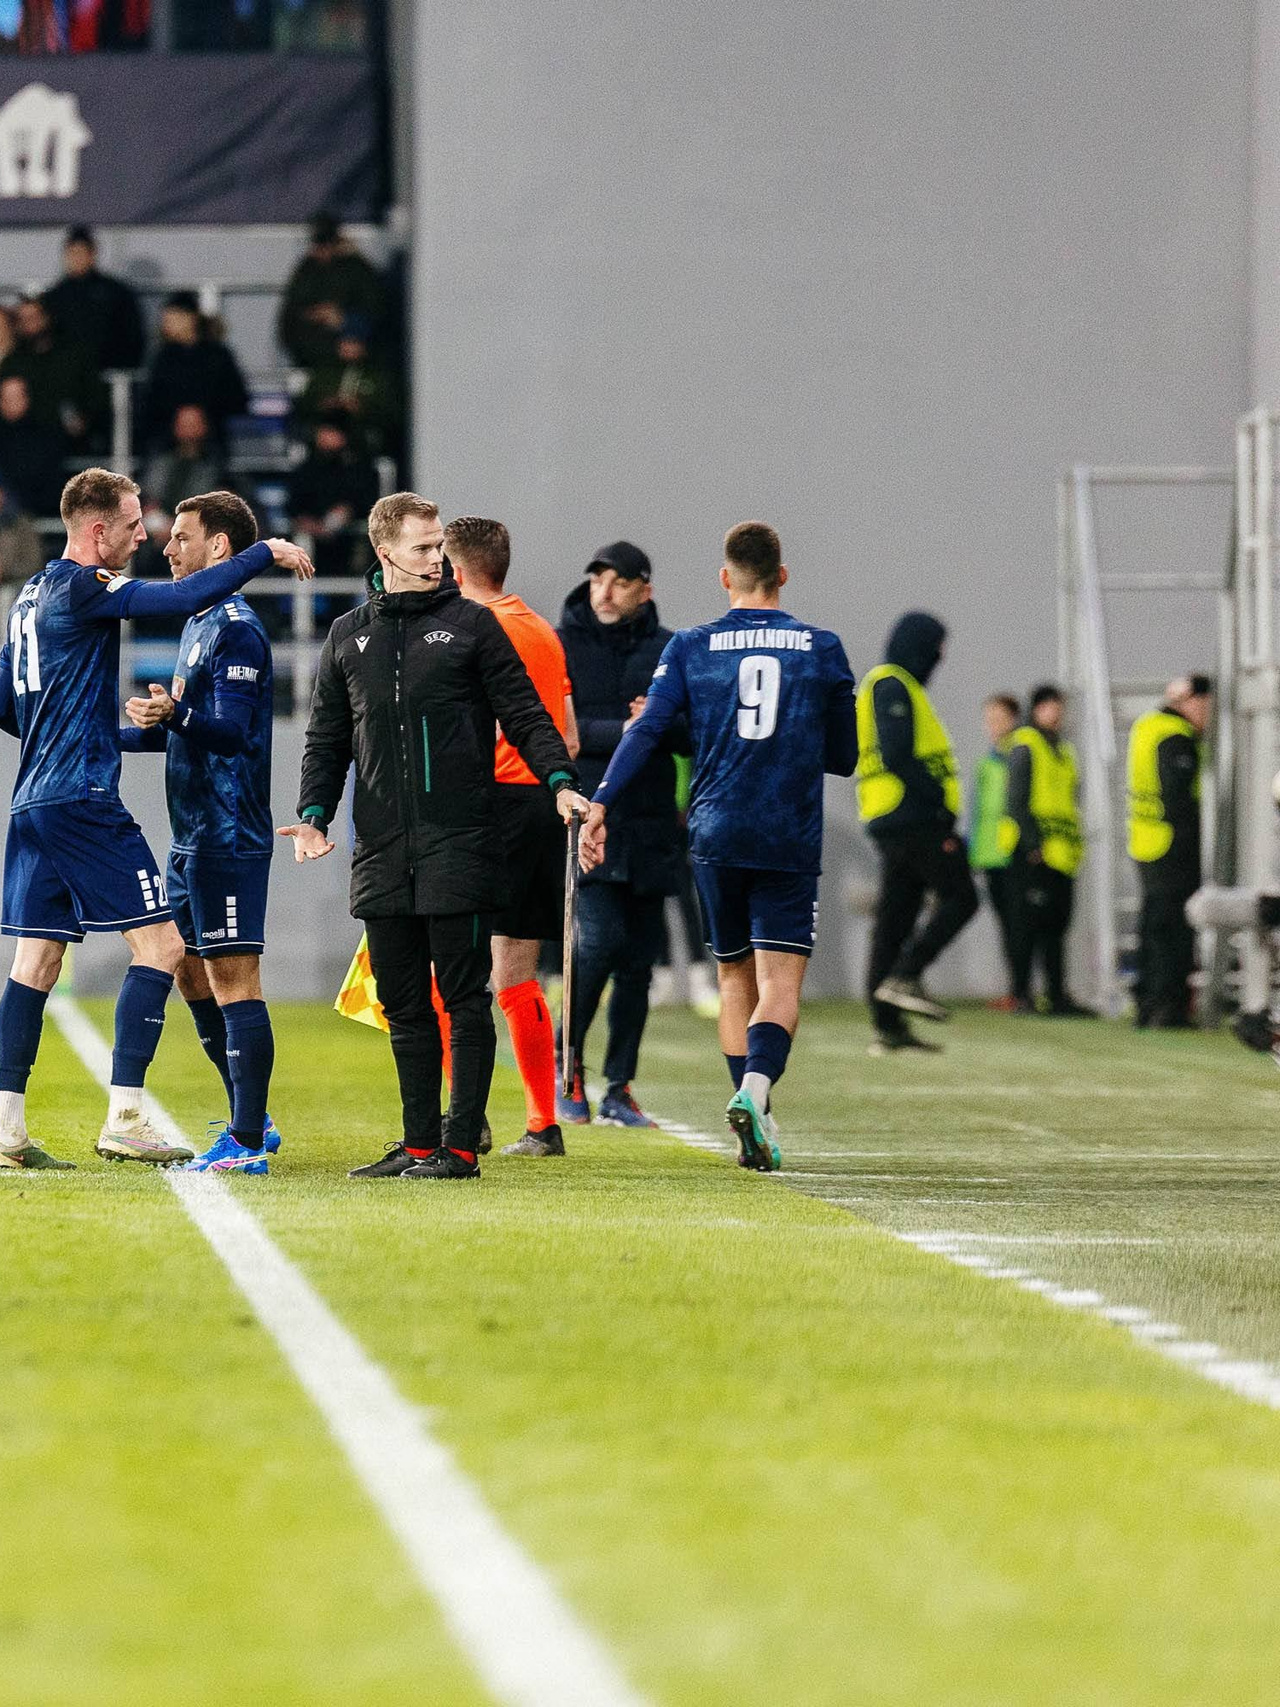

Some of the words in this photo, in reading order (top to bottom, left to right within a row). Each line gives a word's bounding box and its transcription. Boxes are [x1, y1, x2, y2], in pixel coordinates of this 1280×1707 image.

[10, 606, 41, 697] 21
[424, 631, 452, 644] UEFA
[737, 655, 781, 740] 9
[153, 875, 168, 907] 2
